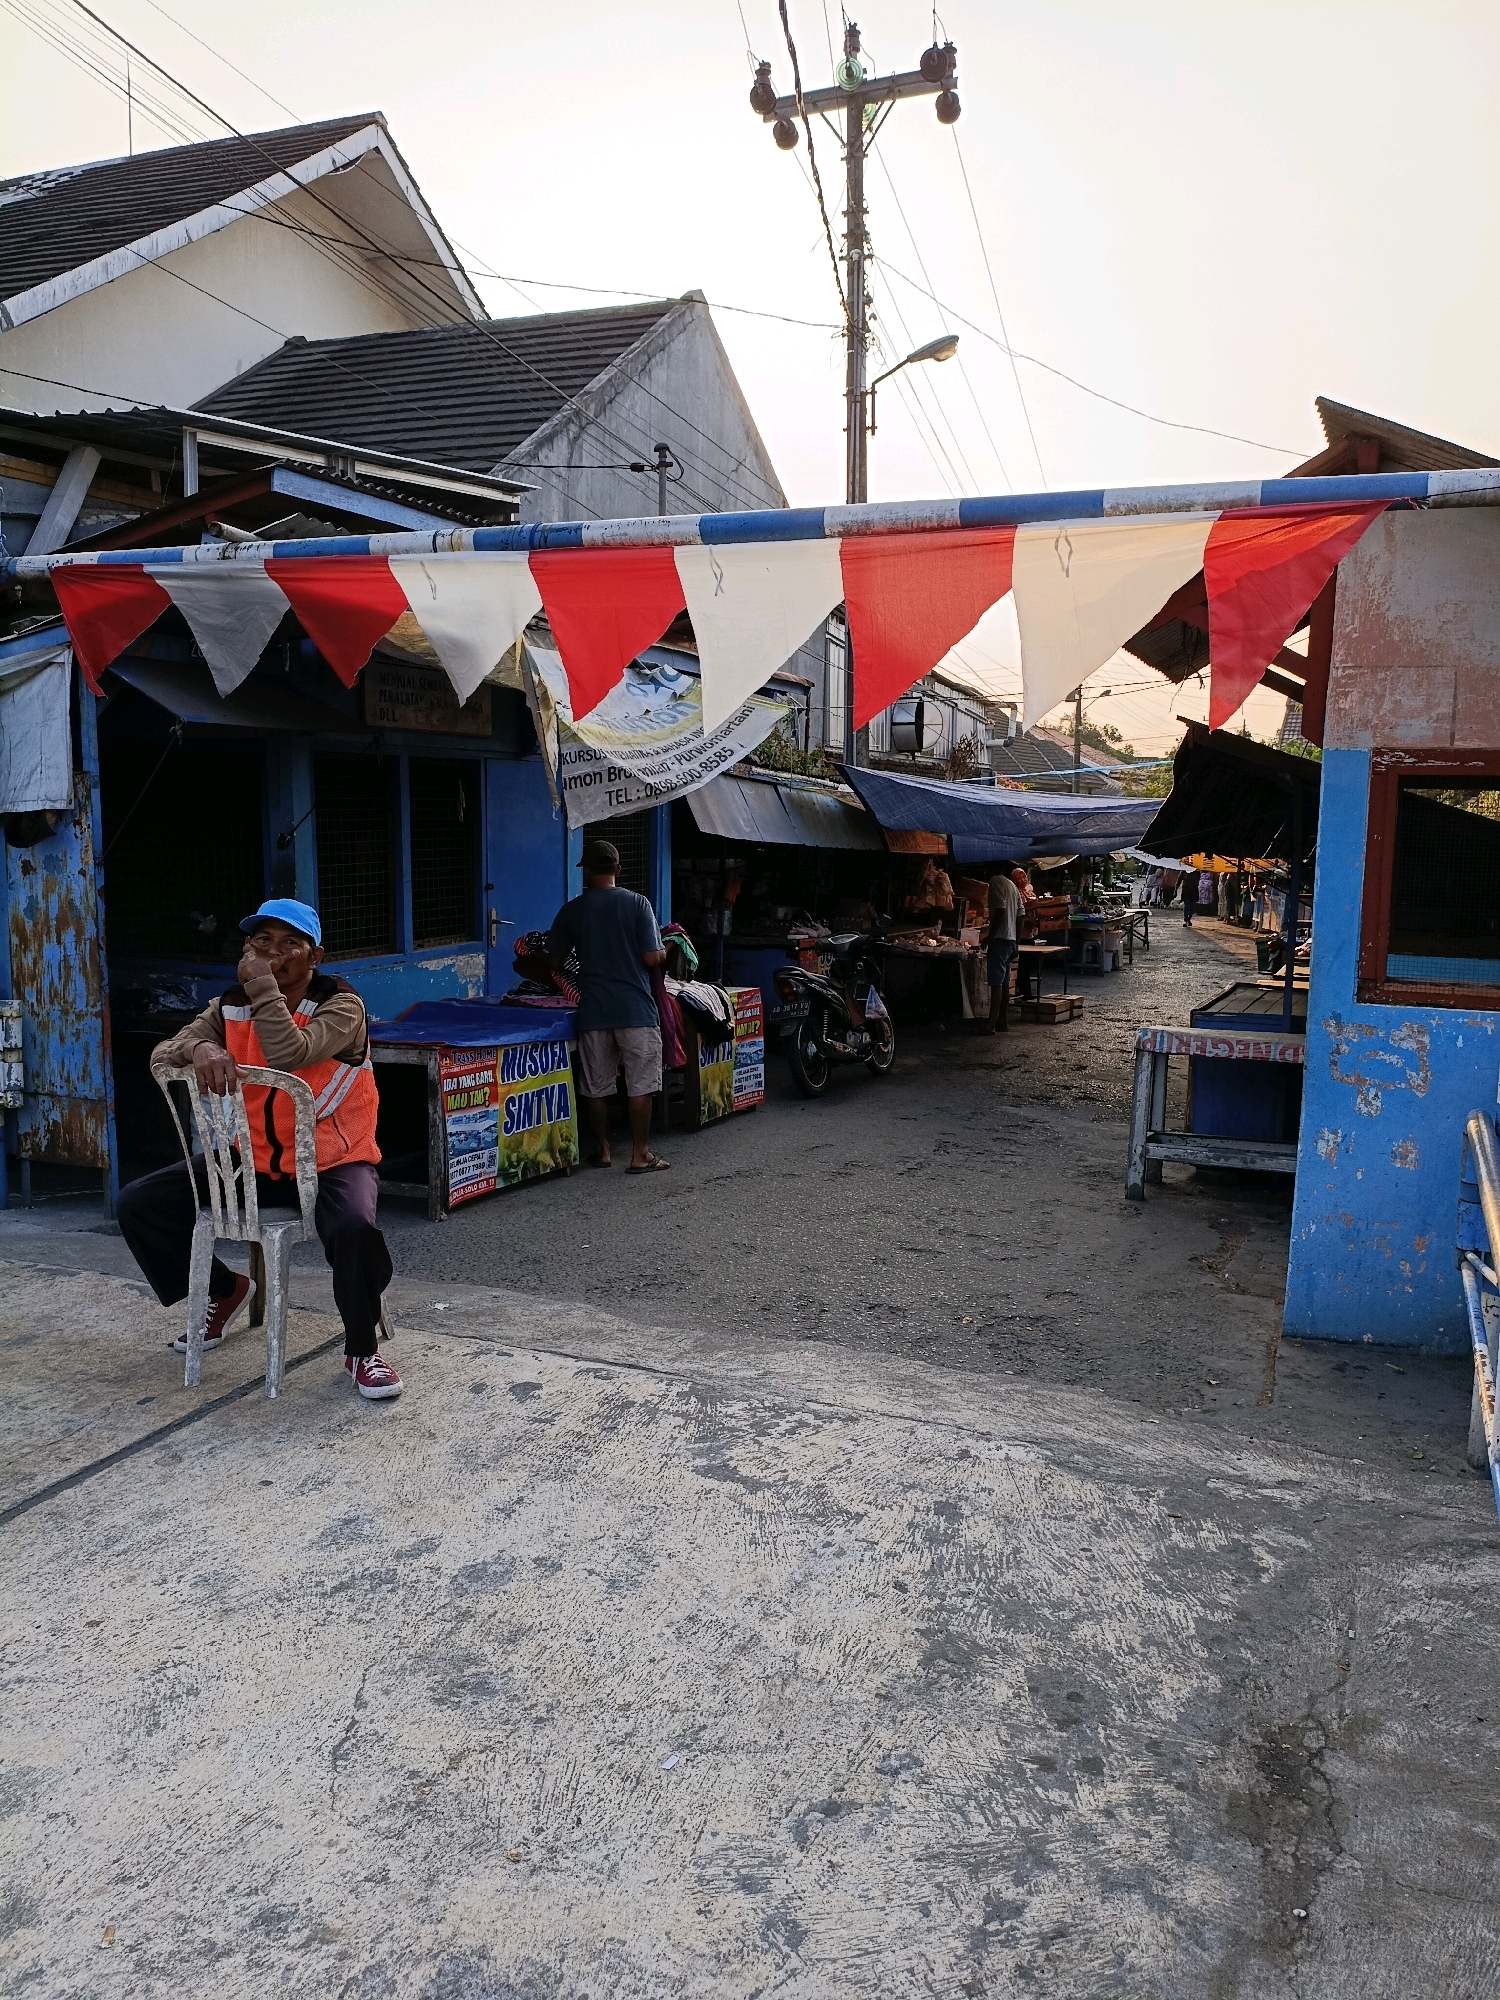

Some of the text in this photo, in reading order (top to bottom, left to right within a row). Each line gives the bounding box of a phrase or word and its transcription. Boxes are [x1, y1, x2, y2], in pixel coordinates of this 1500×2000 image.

[562, 748, 607, 765] KURSUS
[661, 736, 695, 753] BAHASA
[673, 704, 756, 766] Purwomartani
[604, 786, 632, 806] TEL
[501, 1041, 569, 1085] MUSOFA
[447, 1093, 468, 1111] MAU
[502, 1082, 571, 1137] SINTYA
